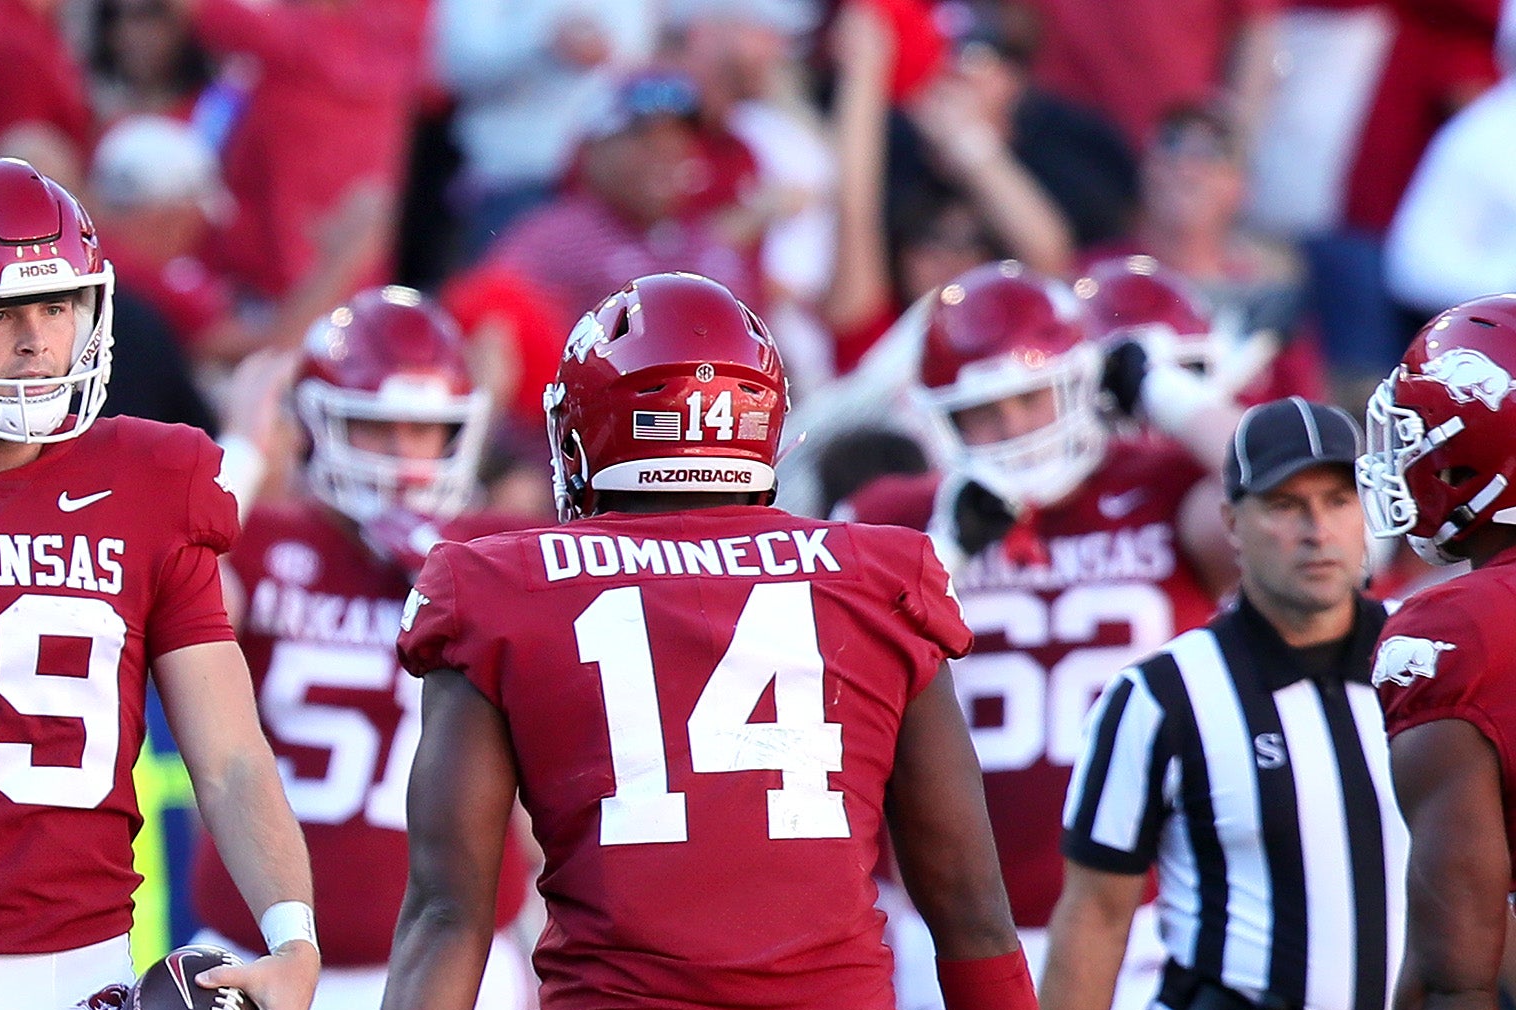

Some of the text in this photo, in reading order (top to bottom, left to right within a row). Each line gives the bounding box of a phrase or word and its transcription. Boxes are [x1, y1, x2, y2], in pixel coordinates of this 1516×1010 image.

[20, 263, 58, 277] HOGS
[685, 391, 734, 441] 14
[638, 470, 752, 484] RAZORBACKS
[538, 528, 842, 582] DOMINECK
[573, 580, 851, 846] 14
[1253, 732, 1285, 770] S
